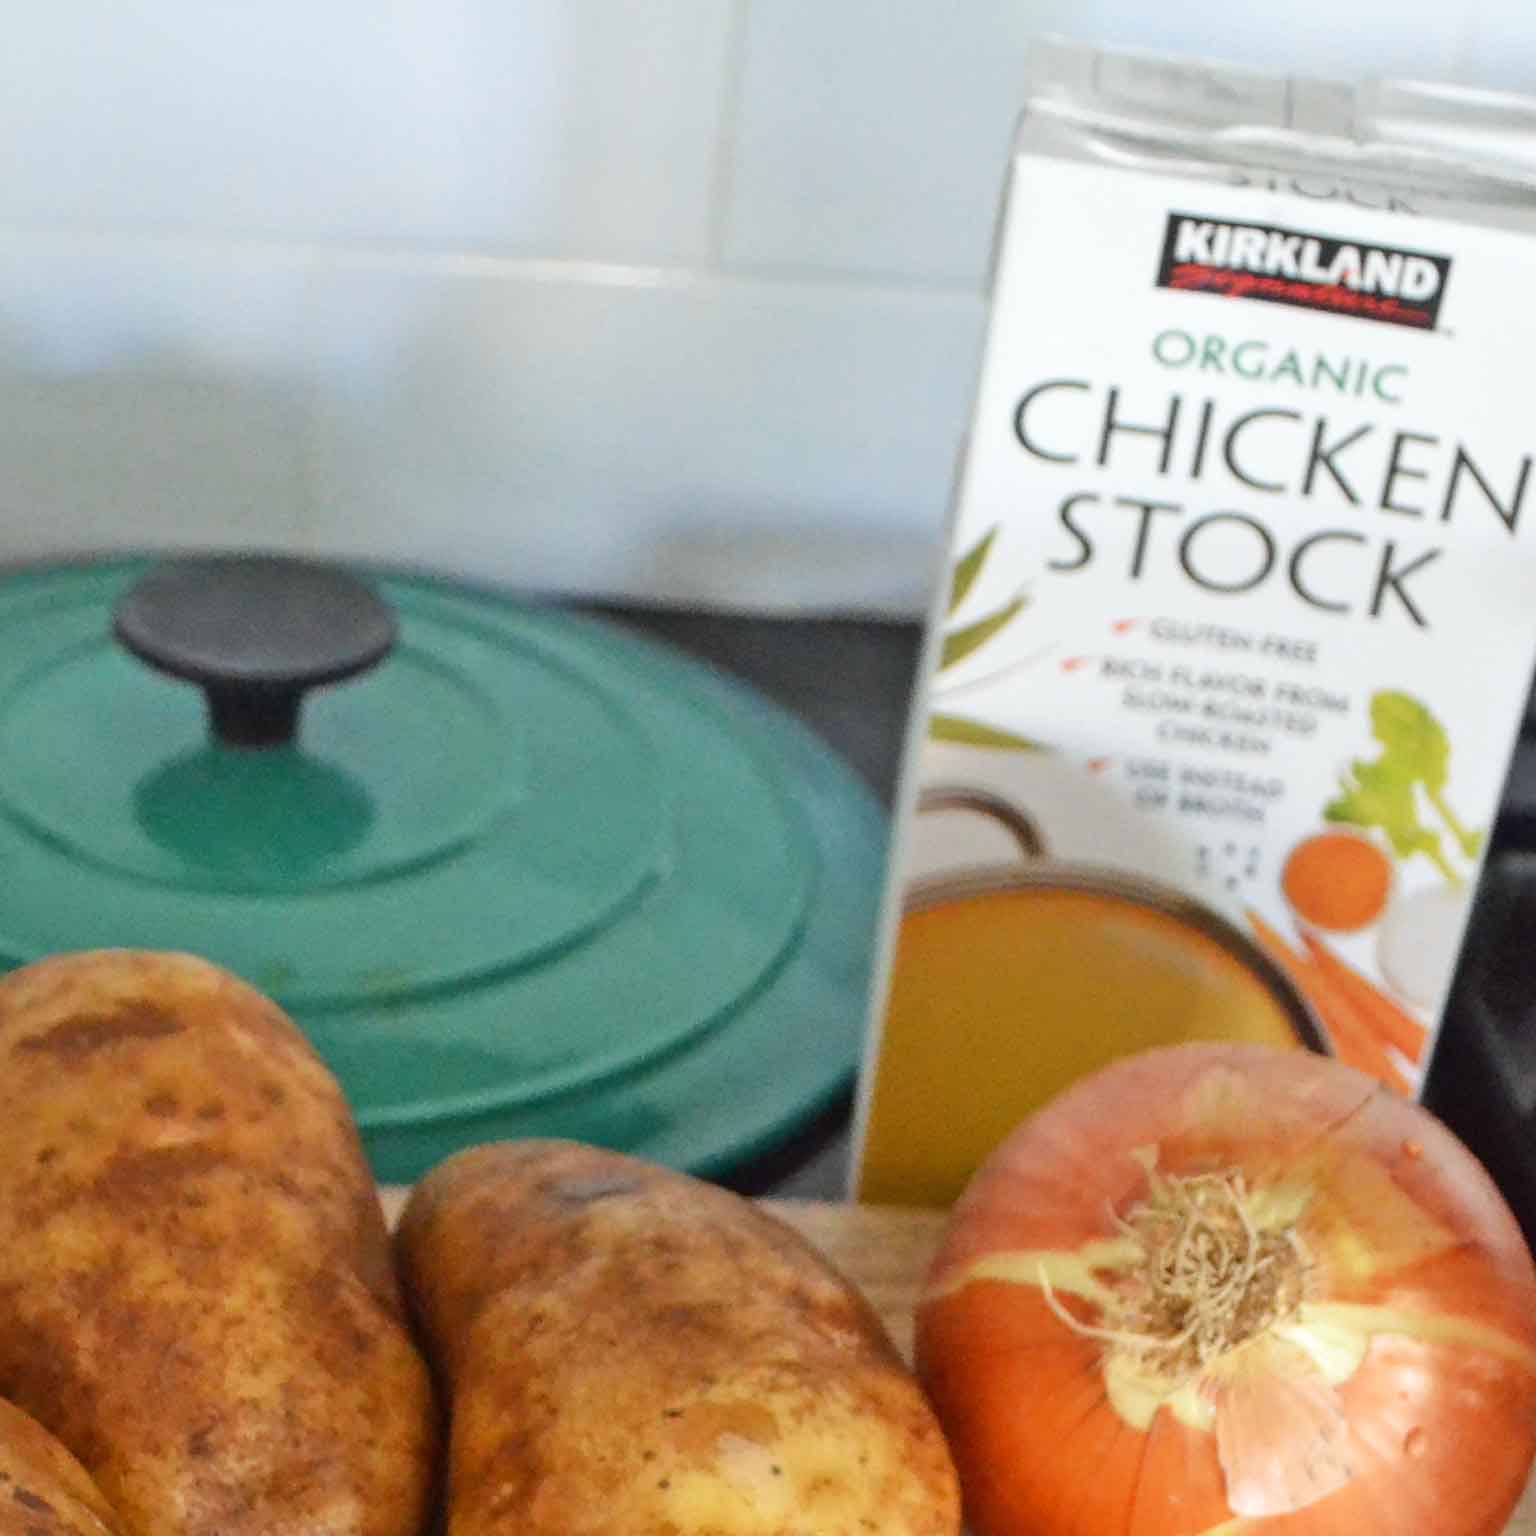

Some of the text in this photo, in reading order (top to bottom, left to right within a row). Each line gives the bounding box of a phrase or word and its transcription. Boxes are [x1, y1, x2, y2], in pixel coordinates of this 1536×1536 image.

[1174, 219, 1441, 301] KIRKLAND
[1152, 329, 1410, 404] ORGANIC
[1013, 378, 1534, 535] CHICKEN
[1047, 492, 1441, 628] STOCK
[1150, 616, 1317, 662] GLUTEN FREE
[1170, 666, 1265, 697] FLAVOR
[1275, 682, 1350, 713] FROM
